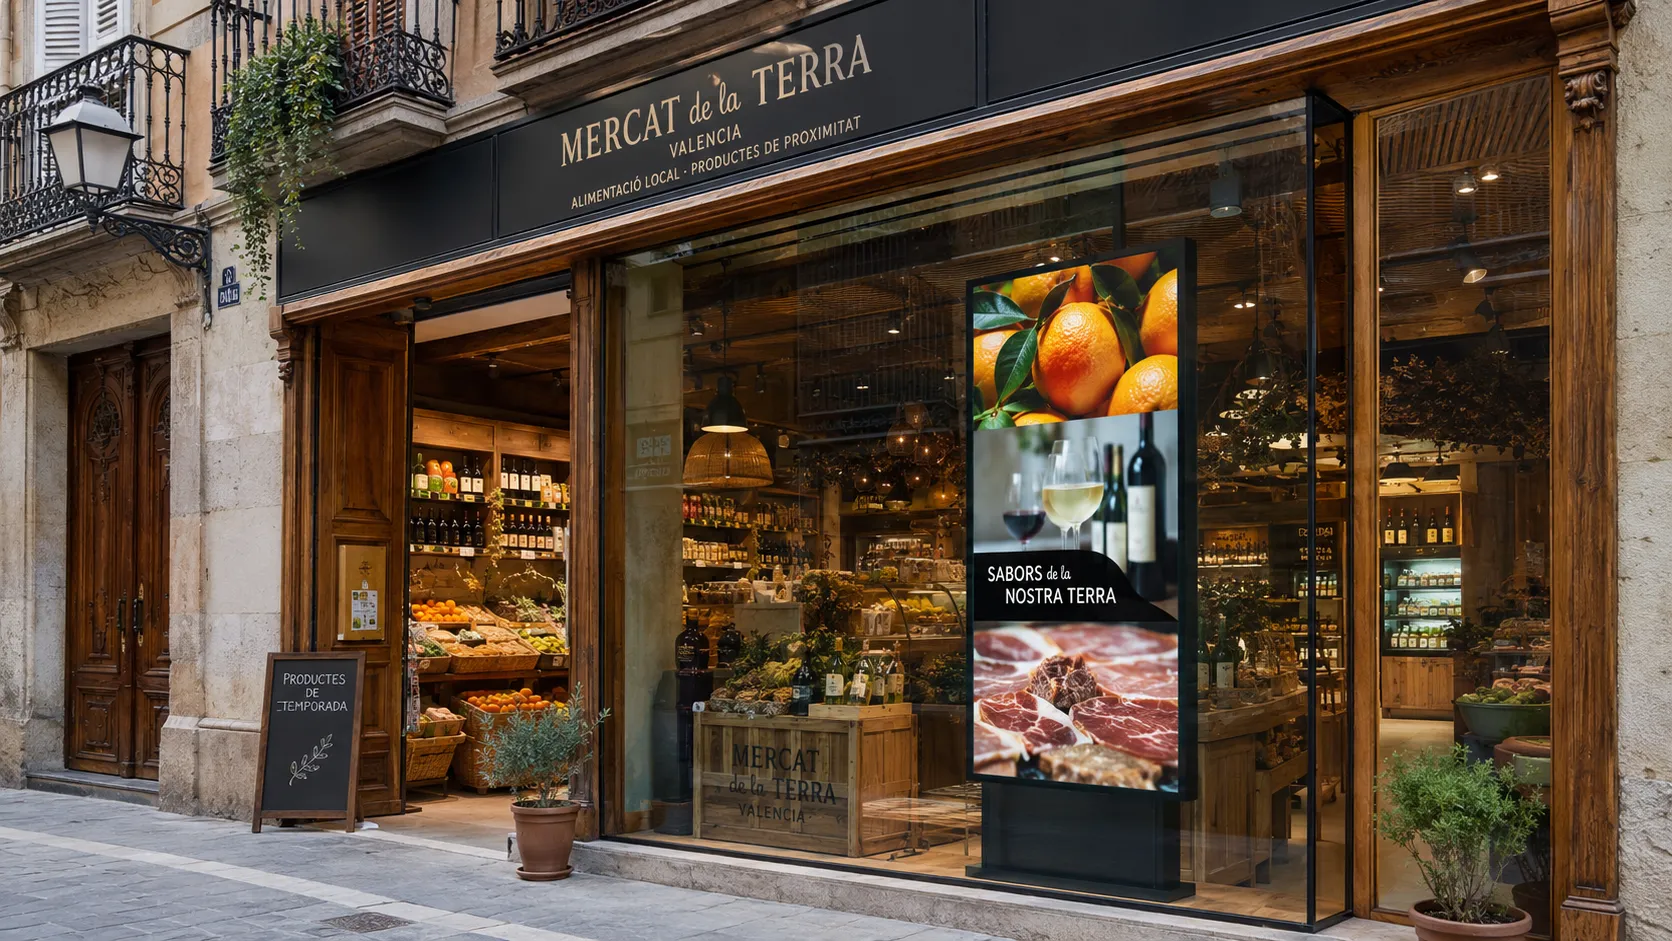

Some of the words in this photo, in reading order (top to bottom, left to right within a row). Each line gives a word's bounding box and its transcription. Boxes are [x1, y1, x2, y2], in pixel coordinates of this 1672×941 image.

[561, 95, 681, 167] MERCAT
[689, 90, 713, 125] de
[718, 81, 742, 114] la
[752, 33, 873, 107] TERRA
[669, 123, 742, 158] VALENCIA
[571, 177, 642, 210] ALIMENTACIÓ
[645, 167, 680, 189] LOCAL
[691, 145, 760, 175] PRODUCTES
[764, 138, 780, 154] DE
[784, 115, 861, 150] PROXIMITAT
[987, 565, 1043, 582] SABORS
[1046, 565, 1059, 580] de
[1060, 565, 1072, 580] la
[1005, 587, 1063, 604] NOSTRA
[1067, 587, 1117, 604] TERRA
[283, 672, 346, 685] PRODUCTES
[305, 688, 320, 698] DE
[733, 743, 820, 773] MERCAT
[729, 773, 747, 795] de
[772, 777, 837, 805] TERRA
[738, 802, 806, 824] VALENCIA
